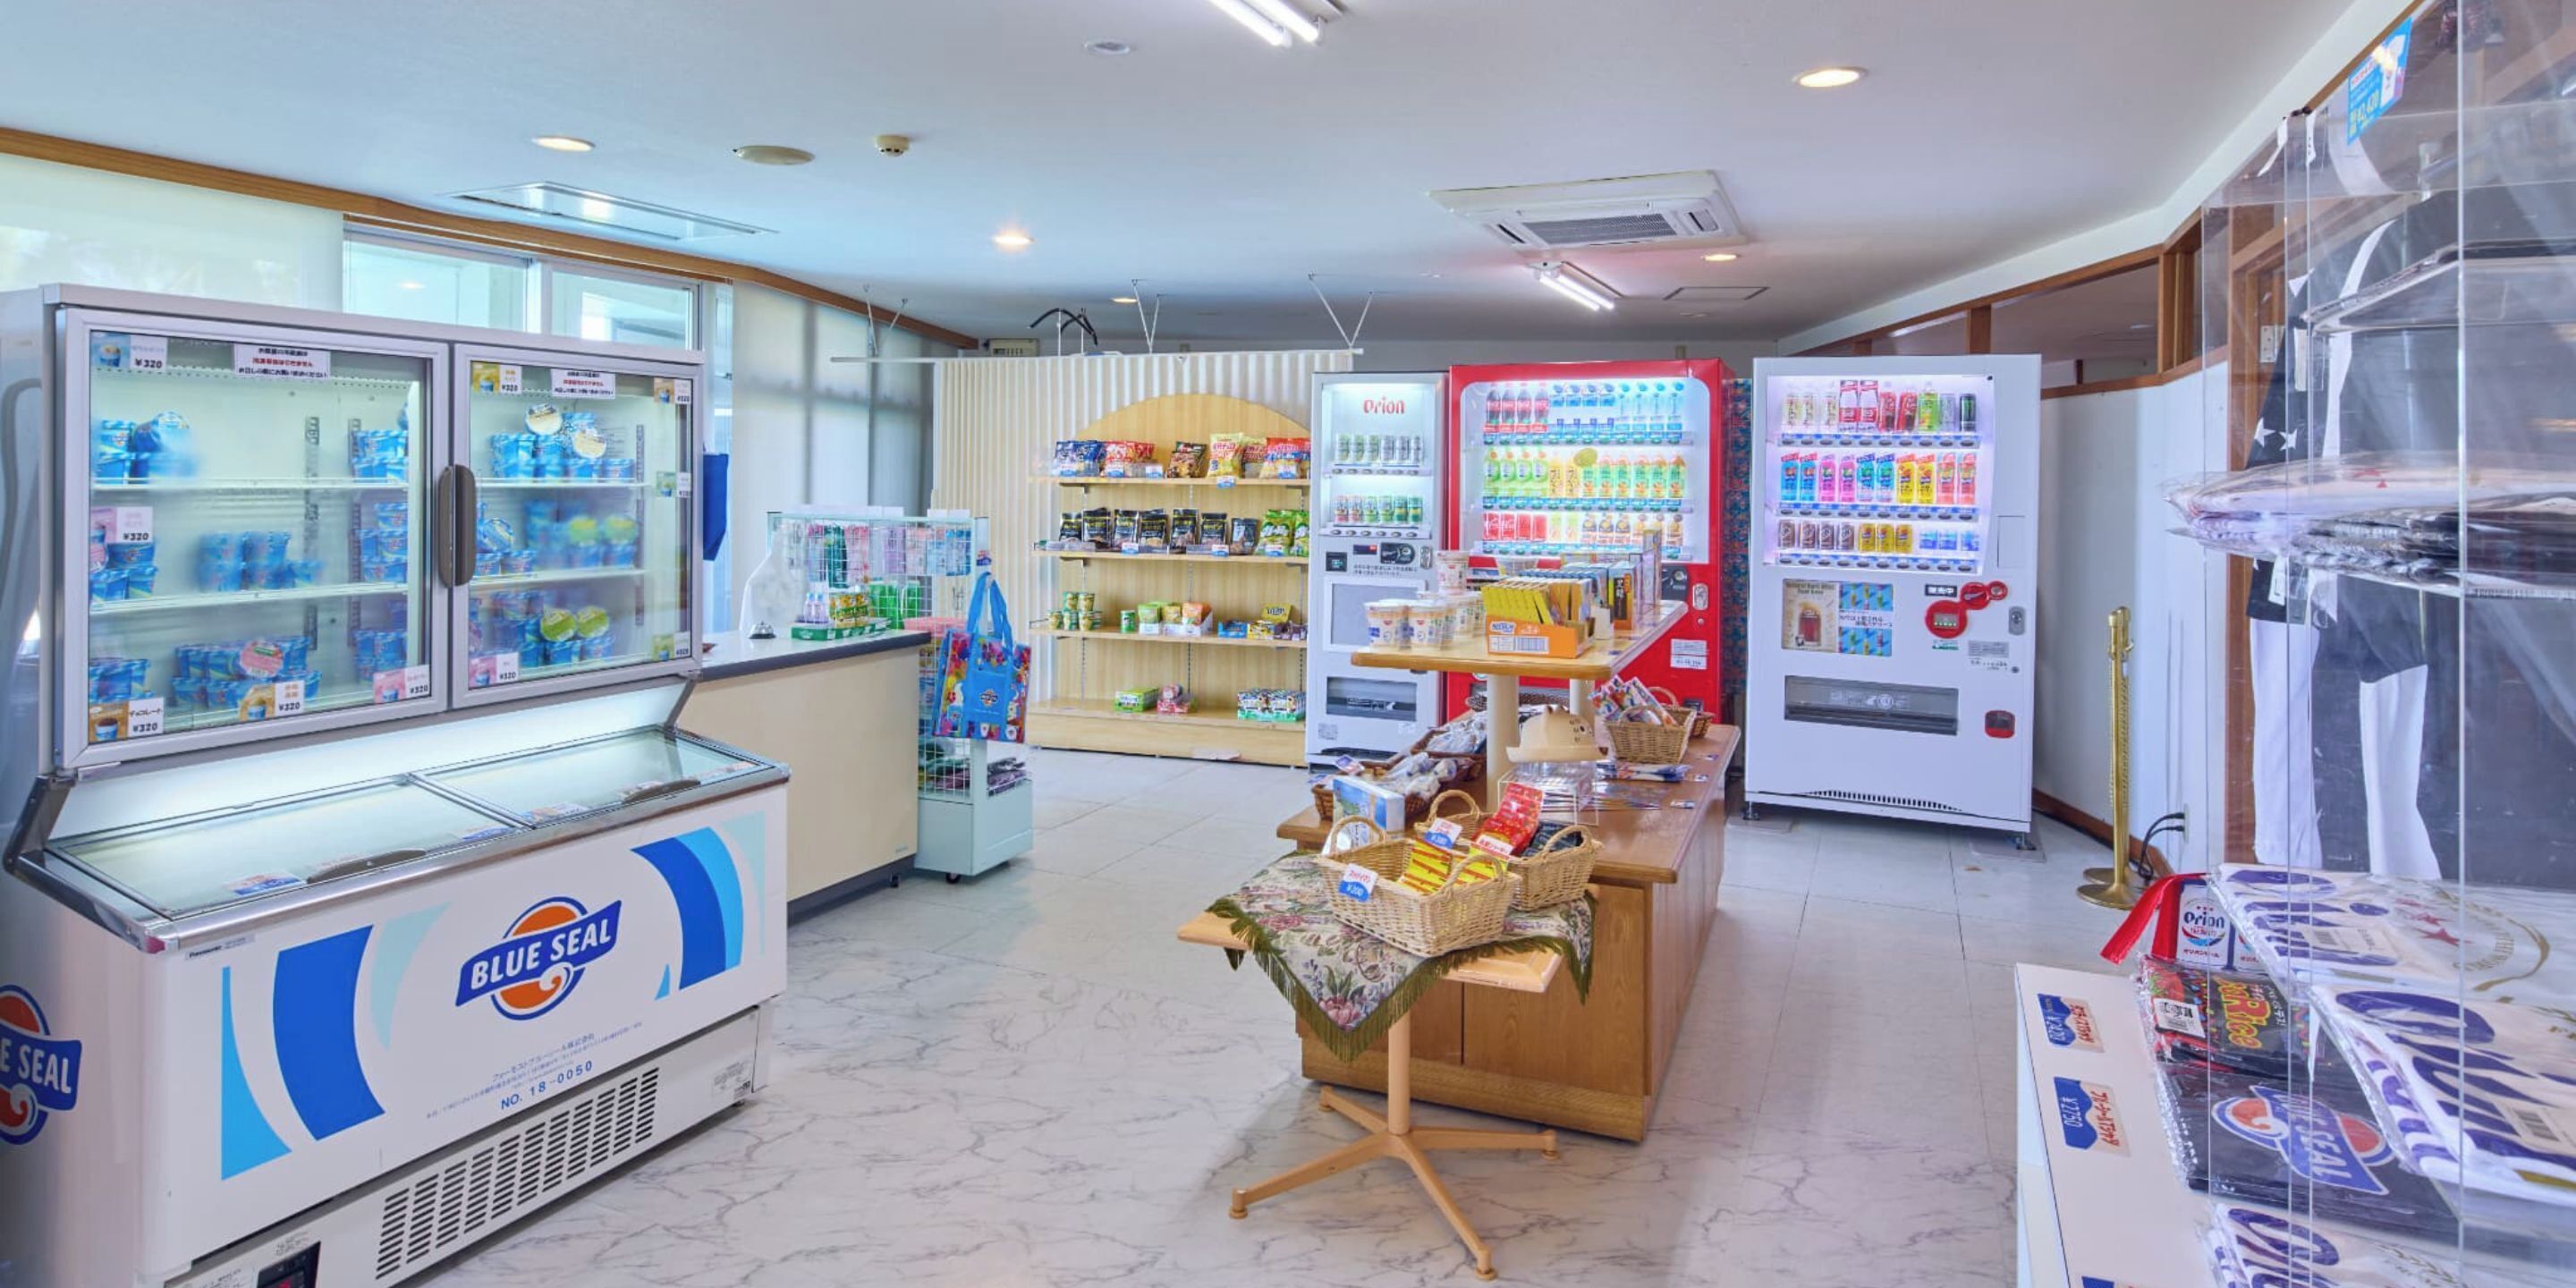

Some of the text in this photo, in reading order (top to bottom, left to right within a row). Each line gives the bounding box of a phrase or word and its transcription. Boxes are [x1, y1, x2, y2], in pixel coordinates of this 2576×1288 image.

[134, 358, 163, 369] ¥320
[1363, 396, 1406, 415] Orion
[278, 701, 301, 712] ¥320
[132, 722, 158, 733] ¥320
[2183, 911, 2225, 930] Orion
[470, 918, 612, 990] BLUE SEAL
[17, 1043, 72, 1094] SEAL
[500, 1092, 524, 1111] NO.
[530, 1059, 593, 1097] 18-0050
[2294, 1124, 2353, 1179] SEAL
